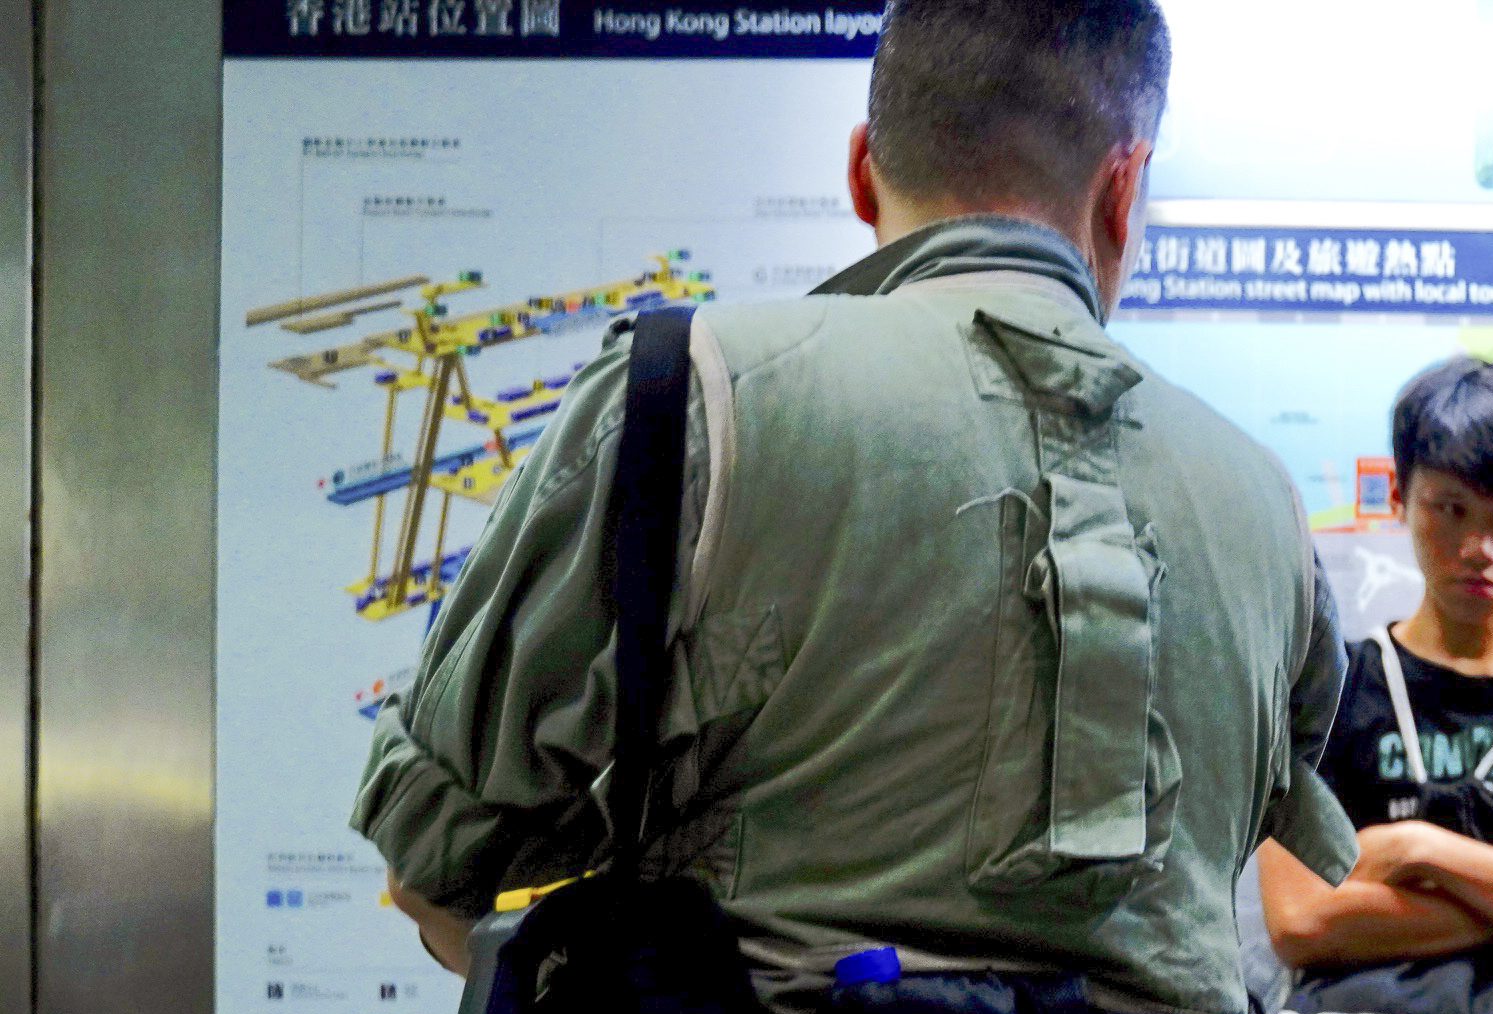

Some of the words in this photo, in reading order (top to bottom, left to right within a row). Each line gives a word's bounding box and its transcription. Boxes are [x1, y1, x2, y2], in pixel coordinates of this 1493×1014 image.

[594, 9, 661, 40] Hong
[665, 8, 729, 40] Kong
[734, 8, 821, 34] Station
[1163, 275, 1242, 300] Station
[1244, 278, 1307, 302] street
[1309, 281, 1361, 306] map
[1362, 277, 1413, 302] with
[1414, 277, 1466, 303] local
